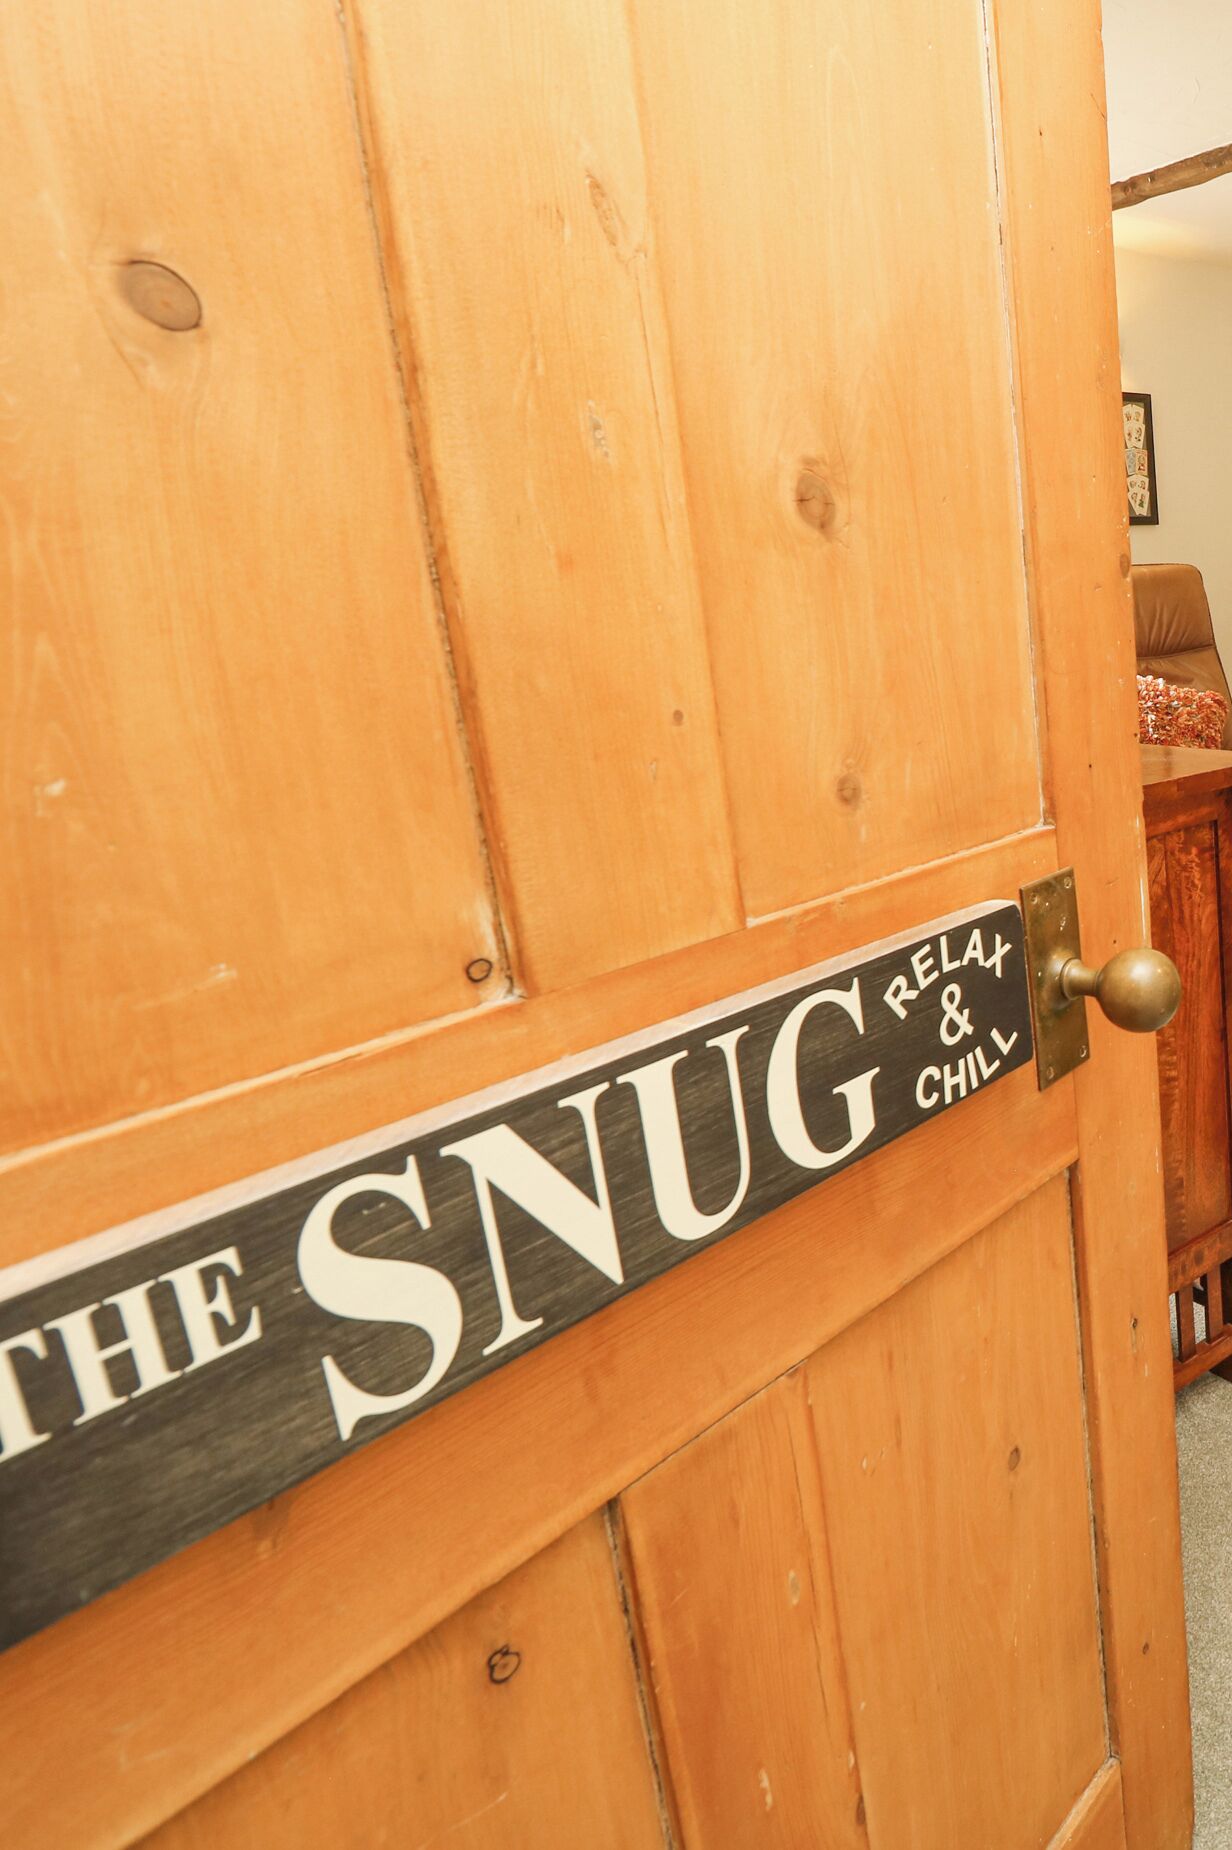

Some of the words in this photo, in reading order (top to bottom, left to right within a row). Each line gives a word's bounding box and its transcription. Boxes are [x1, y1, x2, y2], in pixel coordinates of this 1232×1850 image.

[883, 928, 1012, 1020] RELAX
[939, 983, 974, 1046] &
[915, 1027, 1018, 1109] CHILL
[297, 978, 881, 1441] SNUG
